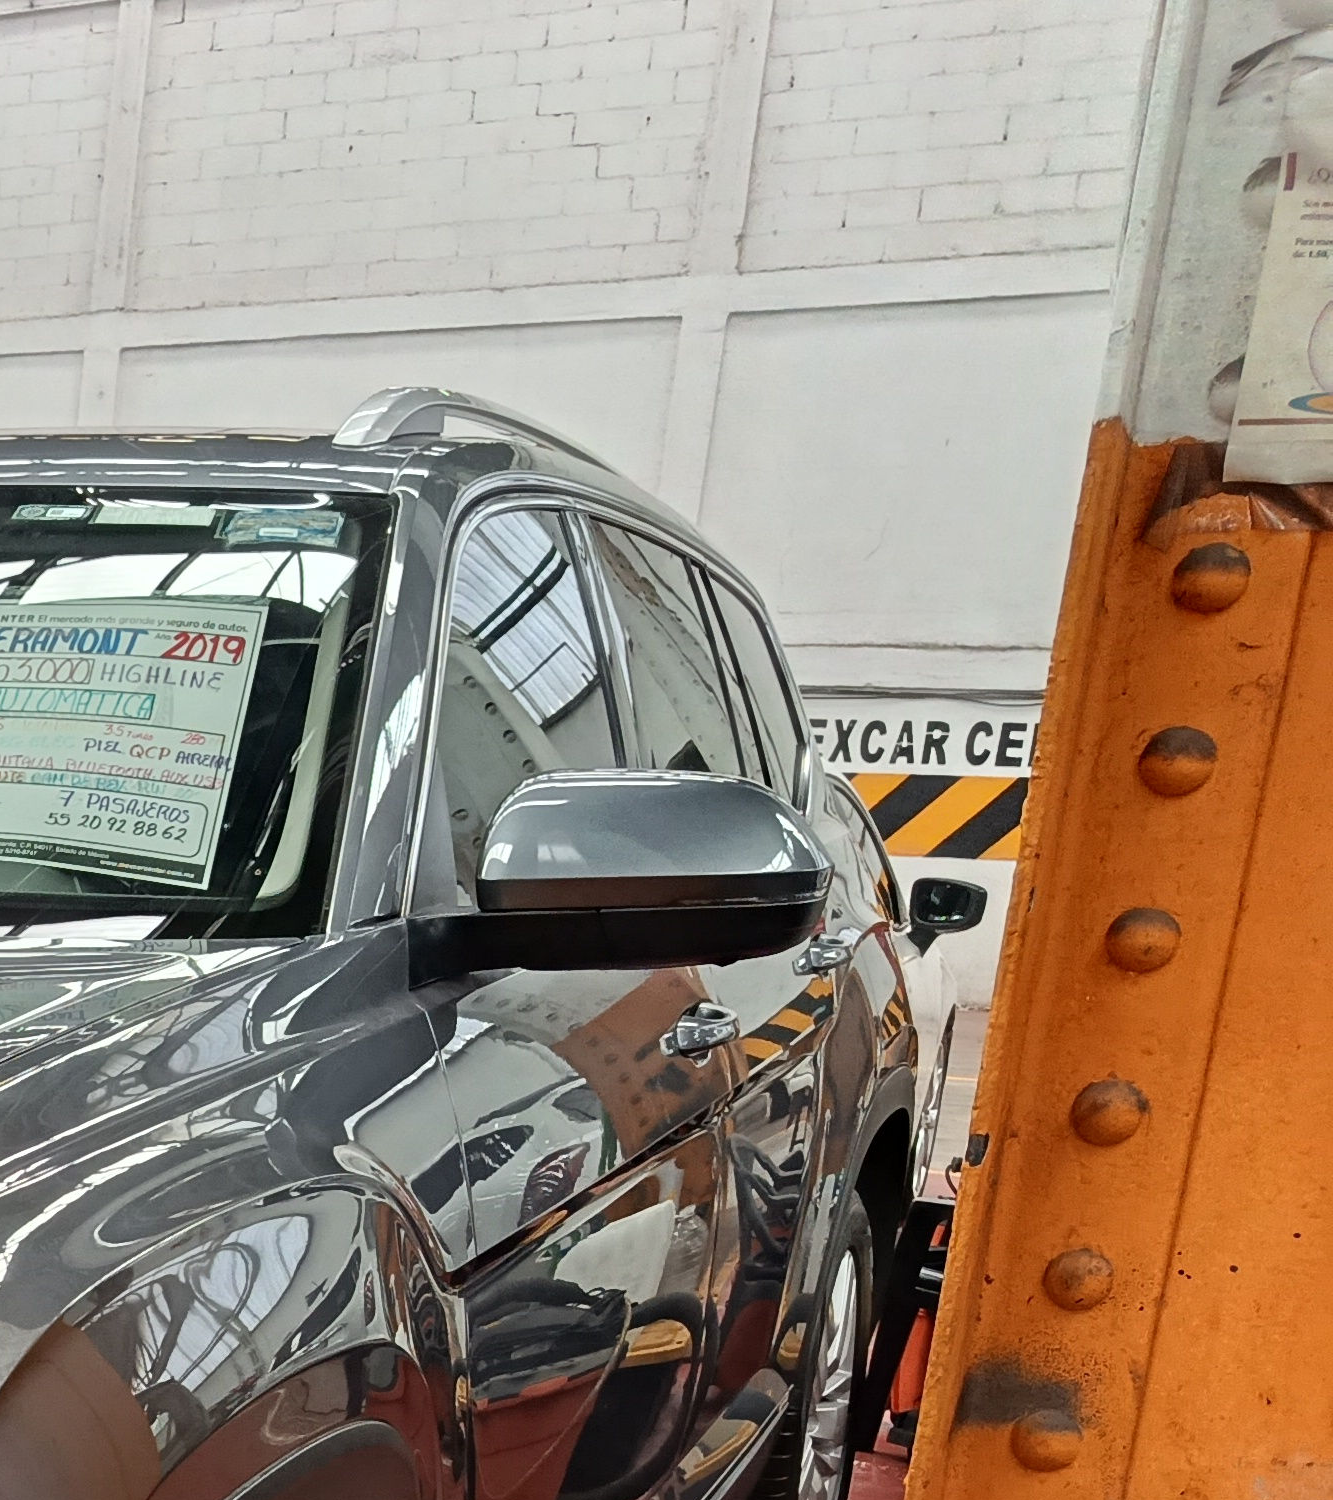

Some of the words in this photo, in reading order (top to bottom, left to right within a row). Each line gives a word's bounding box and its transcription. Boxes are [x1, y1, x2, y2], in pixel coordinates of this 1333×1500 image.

[37, 614, 47, 623] El
[49, 615, 93, 624] mercado
[118, 617, 155, 626] grande
[166, 620, 200, 631] seguro
[202, 620, 215, 630] de
[217, 623, 249, 633] autos.
[160, 631, 247, 664] 2019
[101, 662, 225, 692] HIGHLINE
[83, 737, 122, 754] PIEL
[129, 743, 171, 761] QCP
[964, 720, 1041, 767] CE
[58, 789, 76, 808] 7
[85, 792, 192, 824] PASAJEROS
[43, 812, 72, 826] 55
[76, 814, 103, 831] 20
[106, 816, 128, 833] 92
[132, 822, 159, 838] 88
[161, 826, 188, 844] 62
